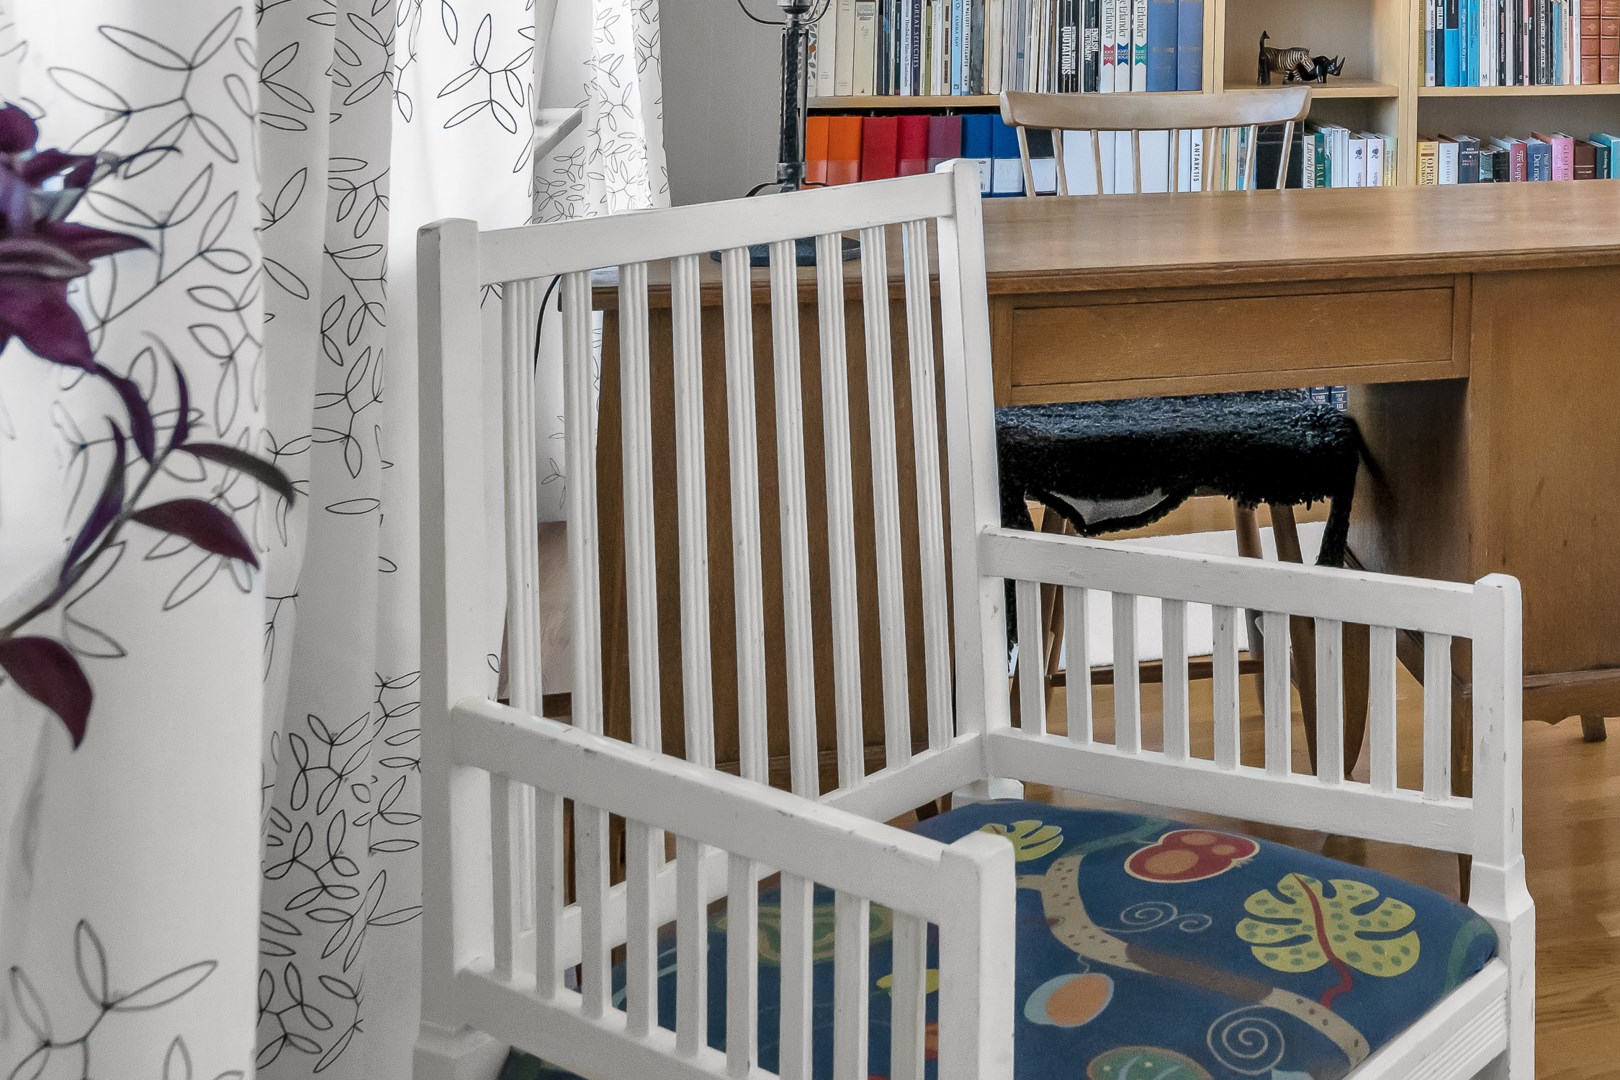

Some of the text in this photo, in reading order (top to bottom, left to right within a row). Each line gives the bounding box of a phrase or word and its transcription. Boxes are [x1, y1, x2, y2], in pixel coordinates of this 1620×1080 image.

[1105, 8, 1114, 40] Erlander
[1118, 6, 1128, 38] Erlander
[1137, 6, 1146, 38] Erlander
[1061, 26, 1071, 75] QUOTATIONS
